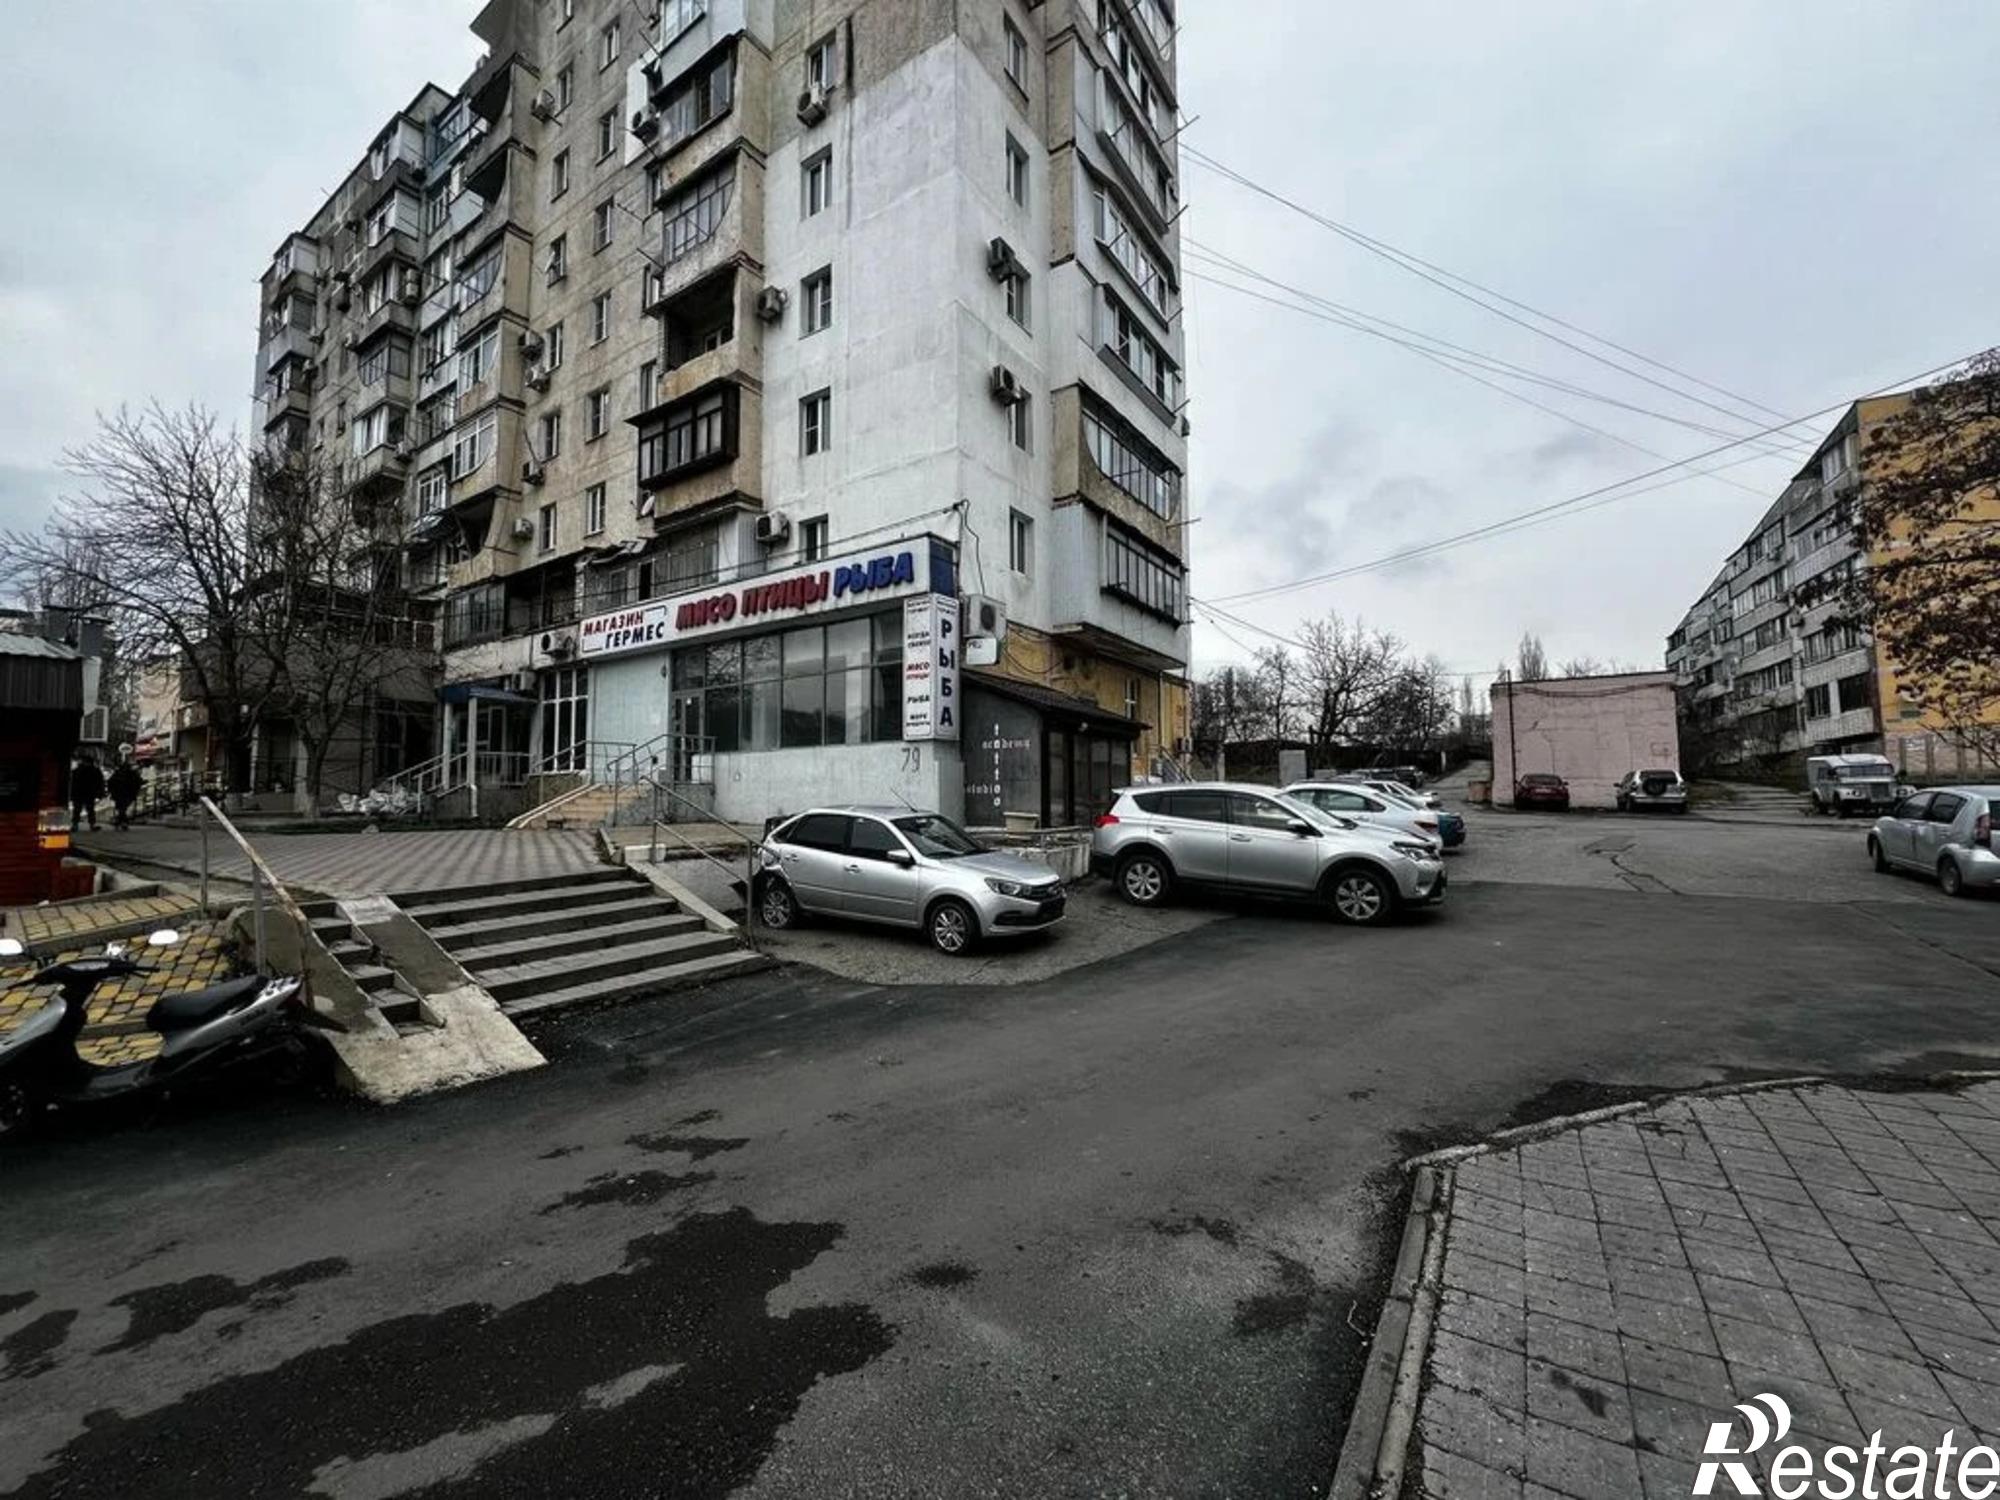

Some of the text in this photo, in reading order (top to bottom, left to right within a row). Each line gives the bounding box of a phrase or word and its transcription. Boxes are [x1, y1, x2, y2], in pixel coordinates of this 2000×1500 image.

[741, 571, 830, 617] ПТИЦЫ
[833, 552, 914, 598] РЫБА
[583, 611, 644, 636] МАГАЗИН
[605, 622, 665, 649] ГЕРМЕС
[939, 618, 956, 727] РЫБА
[901, 746, 921, 773] 79
